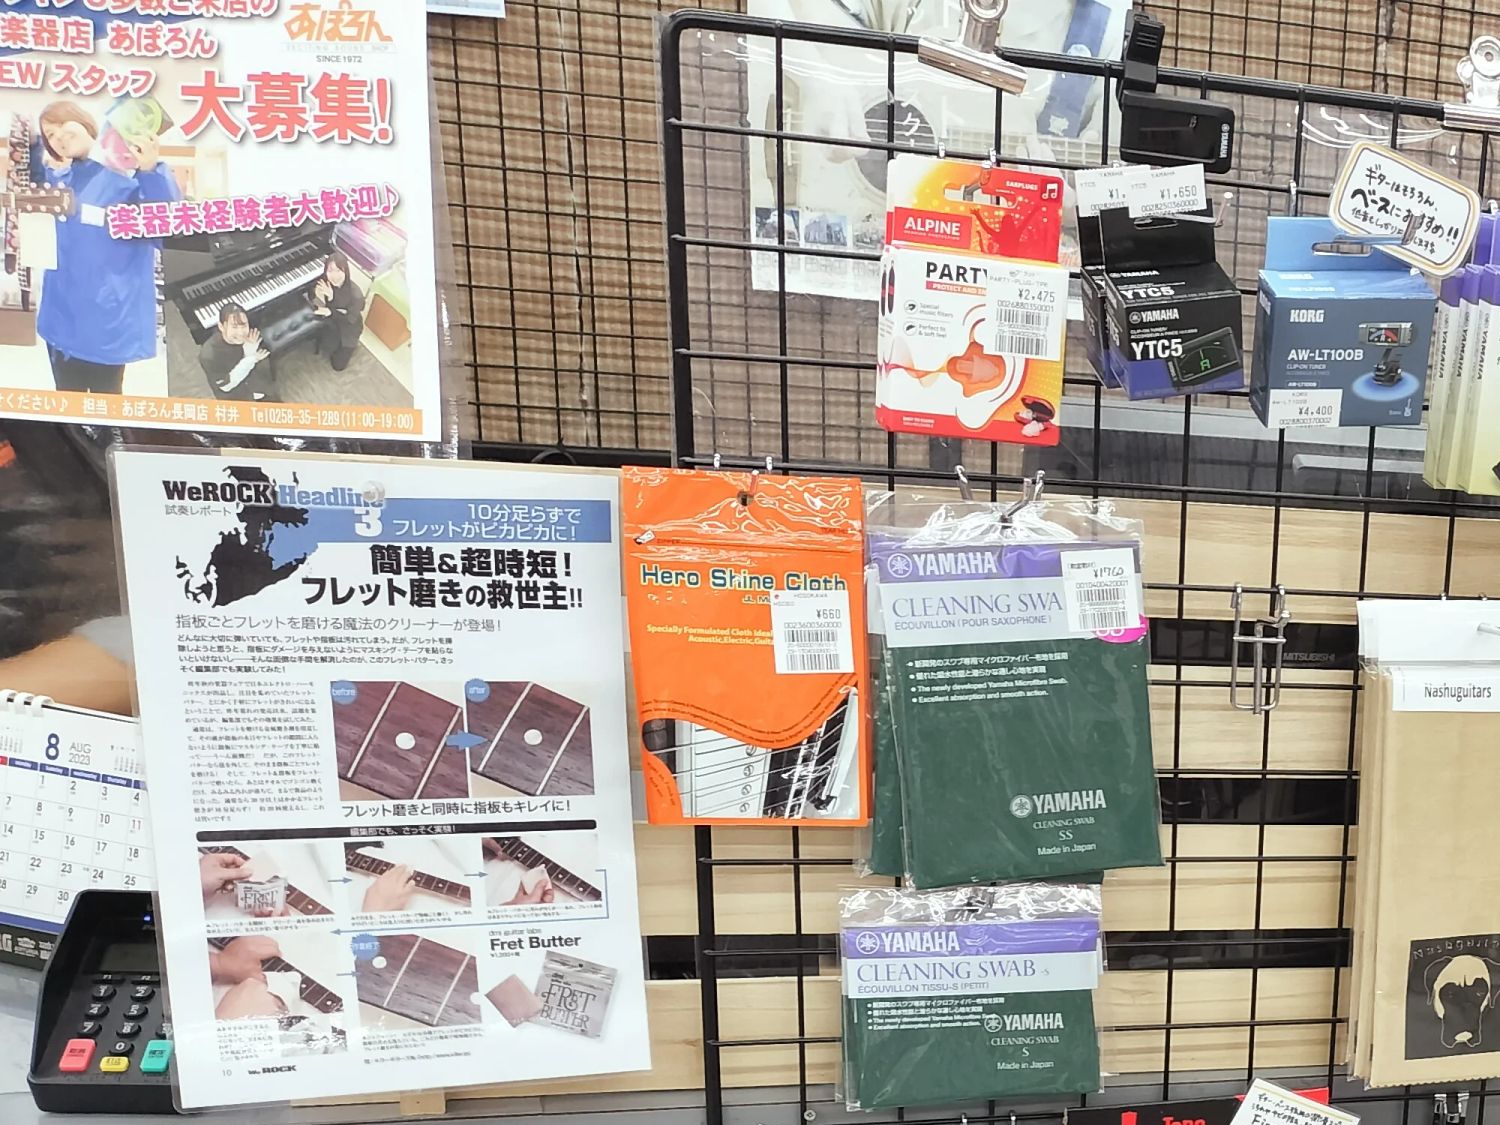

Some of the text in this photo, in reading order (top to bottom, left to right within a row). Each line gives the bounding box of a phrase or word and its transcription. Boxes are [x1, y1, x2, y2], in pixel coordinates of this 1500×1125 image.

[0, 16, 215, 56] 楽器店 あぽろん
[52, 64, 153, 95] スタッフ
[180, 71, 392, 142] 大募集!
[904, 216, 961, 236] ALPINE
[1119, 285, 1175, 299] YTC5
[1140, 307, 1180, 323] YAMAHA
[1289, 309, 1325, 323] KORG
[1131, 338, 1183, 361] YTC5
[1288, 349, 1364, 362] AW-LT100B
[215, 408, 239, 422] 村井
[162, 480, 271, 504] WeROCK
[165, 504, 232, 517] 試奏レポート
[467, 503, 582, 524] 10分足らずで
[354, 509, 383, 537] 3
[912, 551, 998, 577] YAMAHA
[640, 564, 846, 592] Hero Shine Cloth
[816, 608, 841, 620] ¥660
[892, 595, 1011, 618] CLEANING
[894, 620, 956, 631] ECOUVILLON
[1424, 681, 1492, 702] Nashuguitars
[44, 733, 92, 760] 8 AUG
[68, 752, 91, 766] 2023
[1032, 789, 1106, 812] YAMAHA
[99, 813, 110, 824] 10
[1033, 816, 1095, 830] CLEANING SWAB
[1058, 829, 1074, 840] SS
[127, 846, 139, 858] 18
[1037, 846, 1061, 855] Made
[1073, 842, 1096, 854] Japan
[92, 869, 136, 887] 24 25
[489, 933, 582, 952] Fret Butter
[881, 931, 960, 953] YAMAHA
[857, 959, 1036, 982] CLEANING SWAB
[541, 981, 597, 1010] FRET
[858, 984, 919, 993] ECOUVILLON
[921, 982, 959, 992] TISSU-S
[539, 1006, 589, 1031] BUTTER
[1003, 1012, 1064, 1031] YAMAHA
[991, 1035, 1059, 1046] CLEANING SWAB
[1022, 1047, 1029, 1057] S
[997, 1061, 1019, 1070] Made
[1030, 1059, 1054, 1069] Japan
